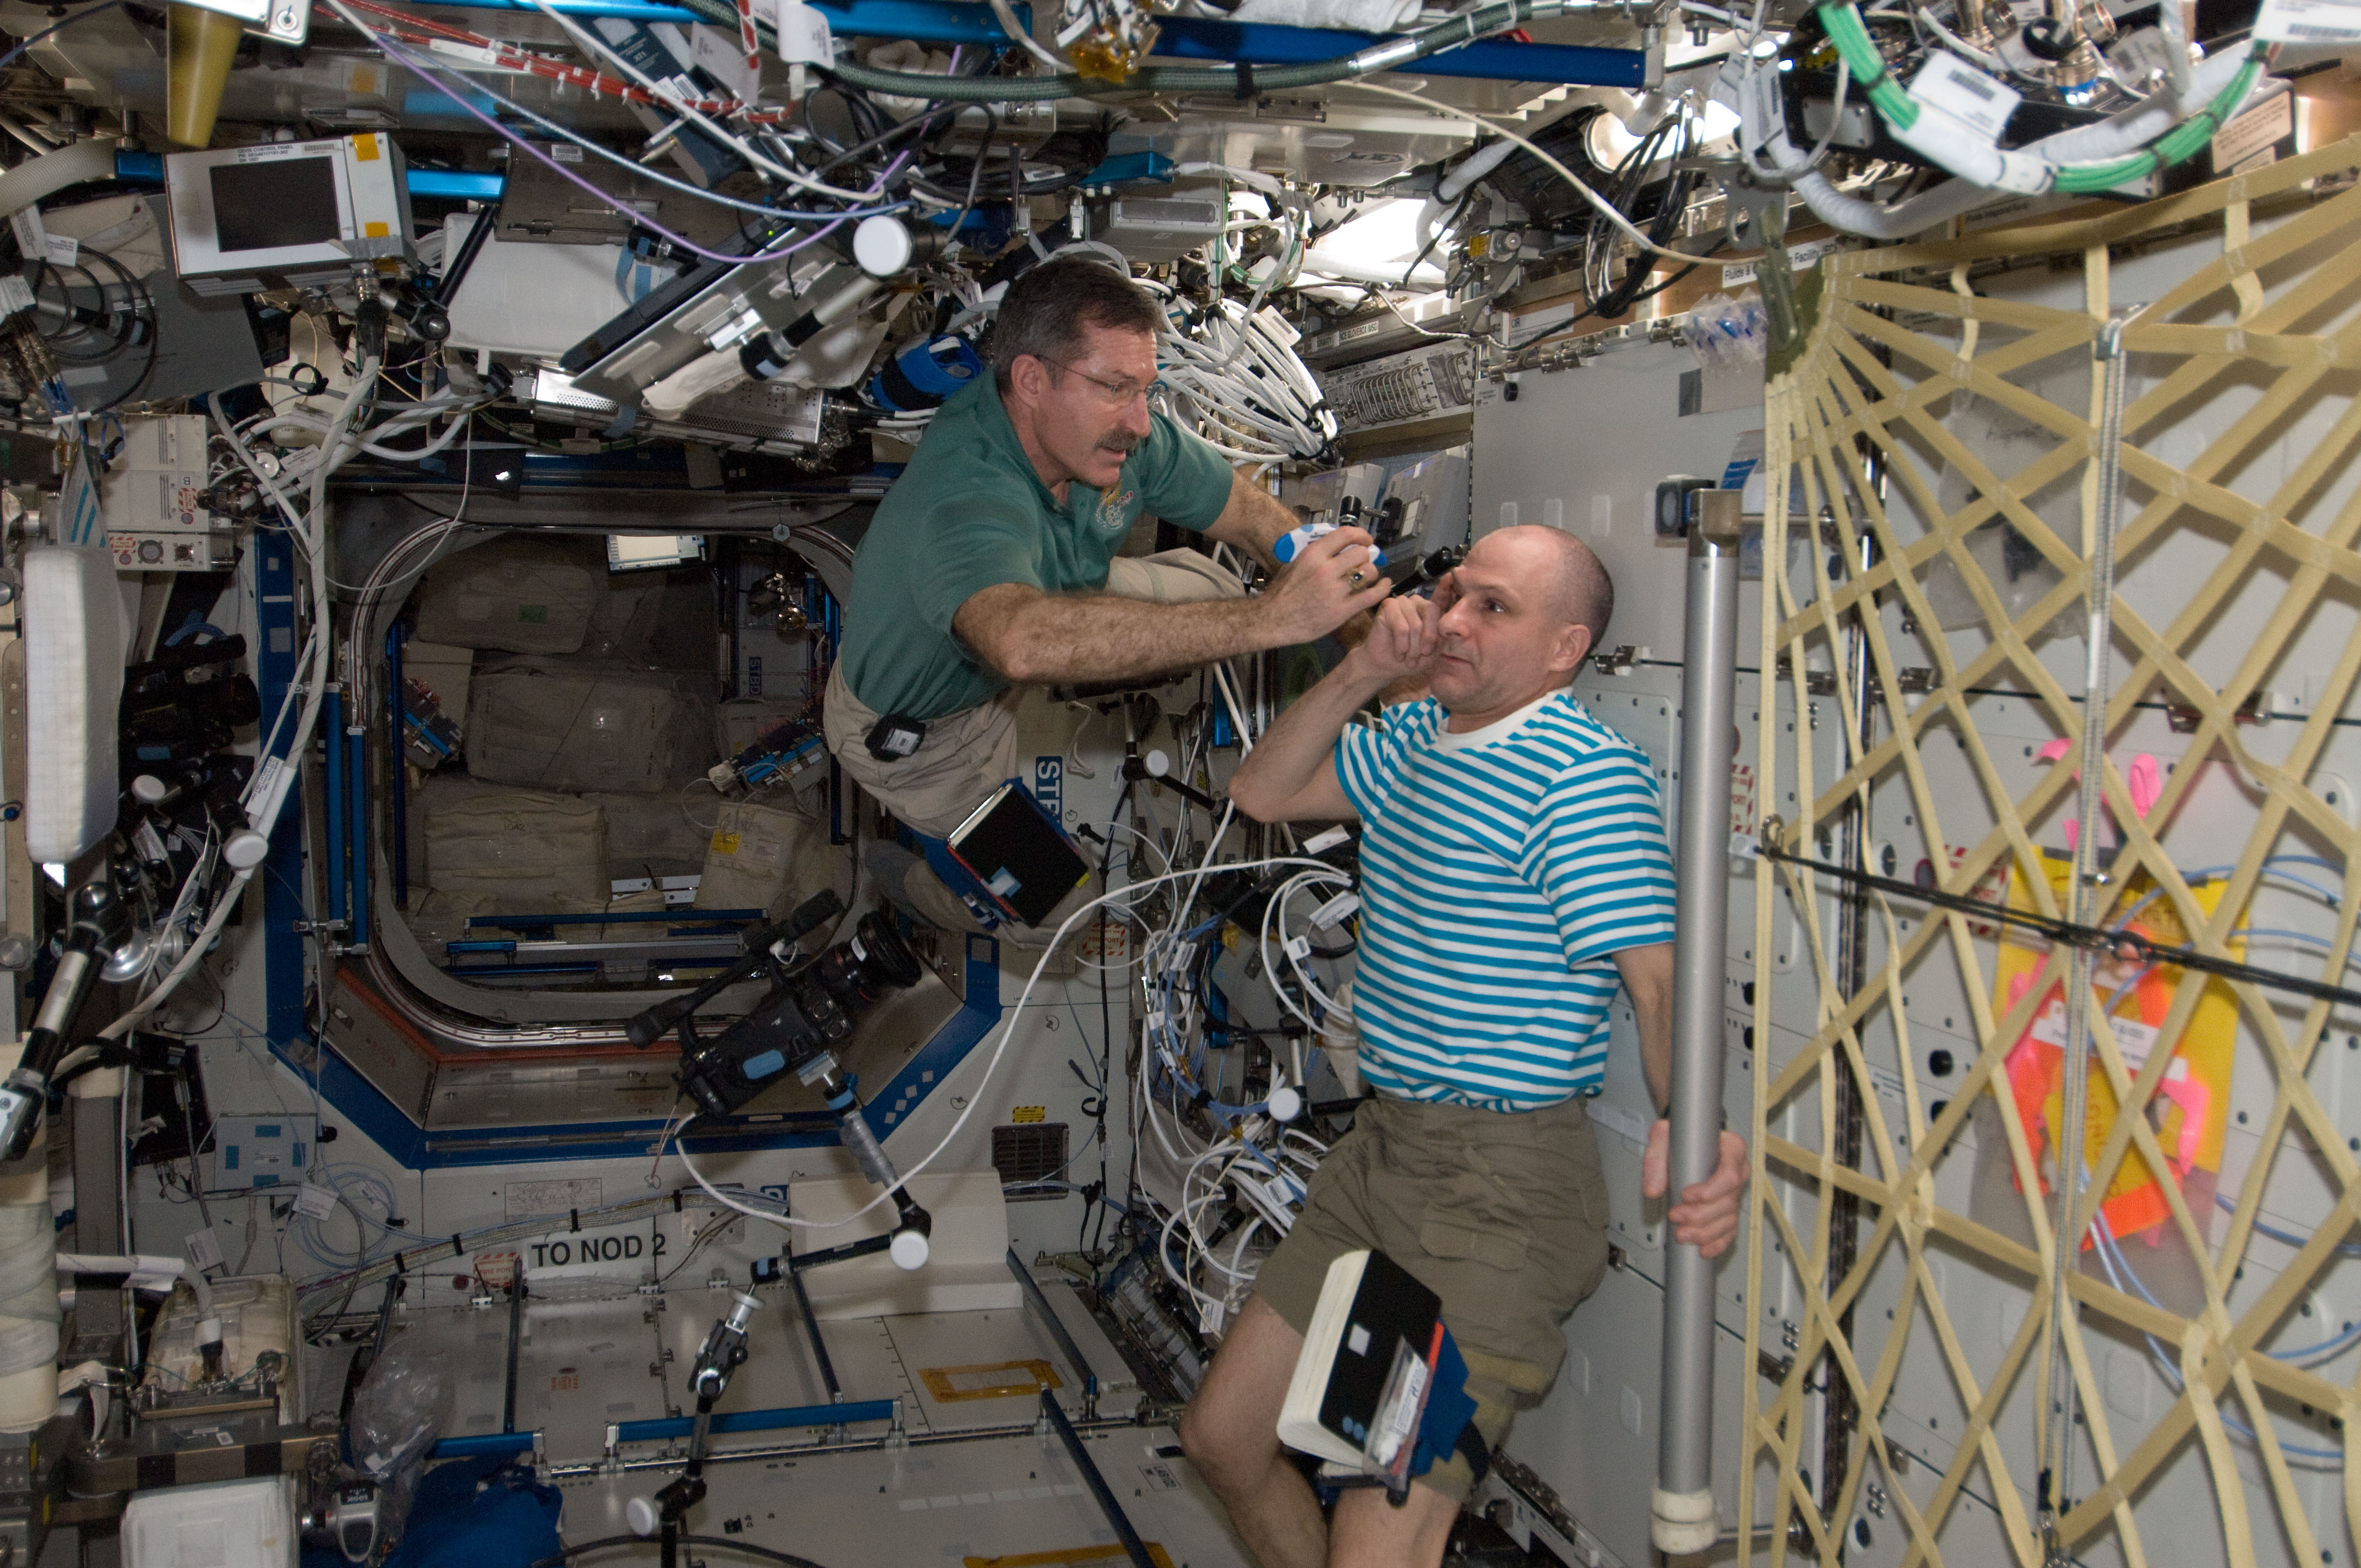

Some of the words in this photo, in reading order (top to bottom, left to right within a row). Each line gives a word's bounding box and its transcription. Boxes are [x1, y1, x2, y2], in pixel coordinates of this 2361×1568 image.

[1724, 268, 1744, 280] Fluids
[1347, 326, 1367, 339] GLOVEBOX
[1119, 490, 1134, 507] 29
[749, 658, 760, 695] STBD
[531, 1242, 571, 1267] TO
[580, 1235, 643, 1264] NOD
[651, 1233, 666, 1256] 2
